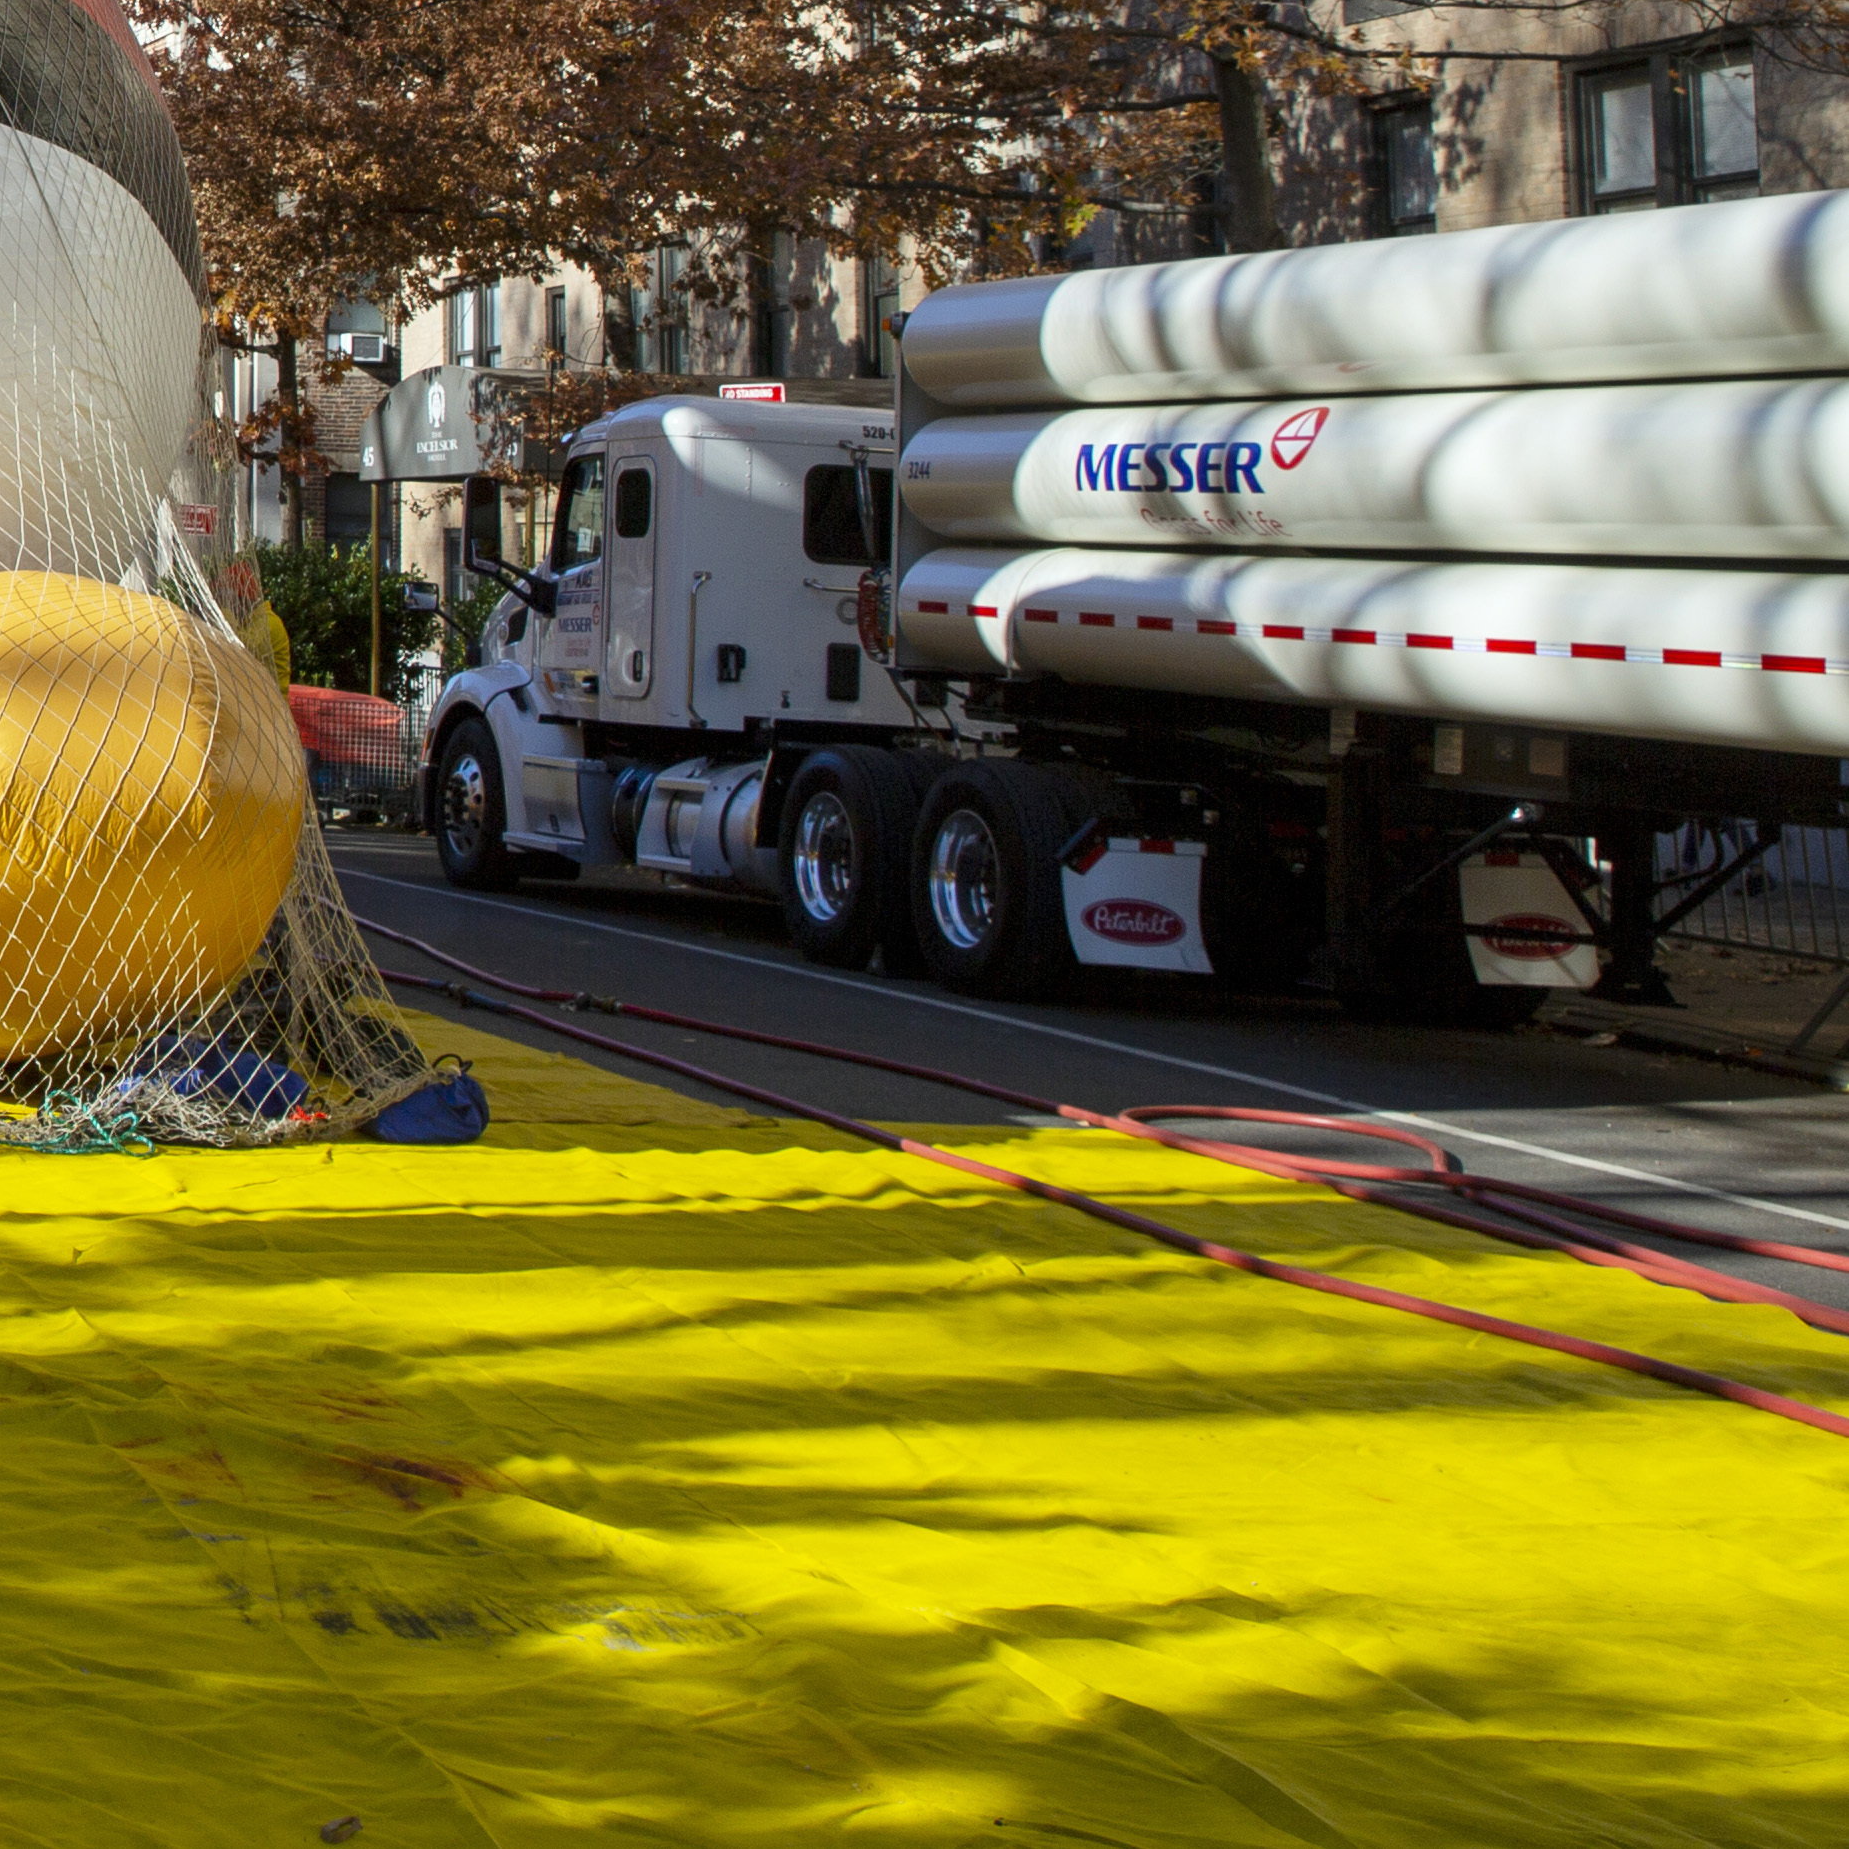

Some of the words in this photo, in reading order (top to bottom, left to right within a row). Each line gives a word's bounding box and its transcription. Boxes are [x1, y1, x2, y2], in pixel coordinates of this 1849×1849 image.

[736, 388, 773, 399] STANDING
[416, 438, 458, 453] EXCELSIOR
[362, 446, 375, 467] 45
[908, 462, 931, 479] 3244
[1076, 442, 1265, 494] MESSER
[1237, 511, 1293, 537] Life
[559, 618, 592, 632] MESSER
[1093, 905, 1175, 935] Peterbilt
